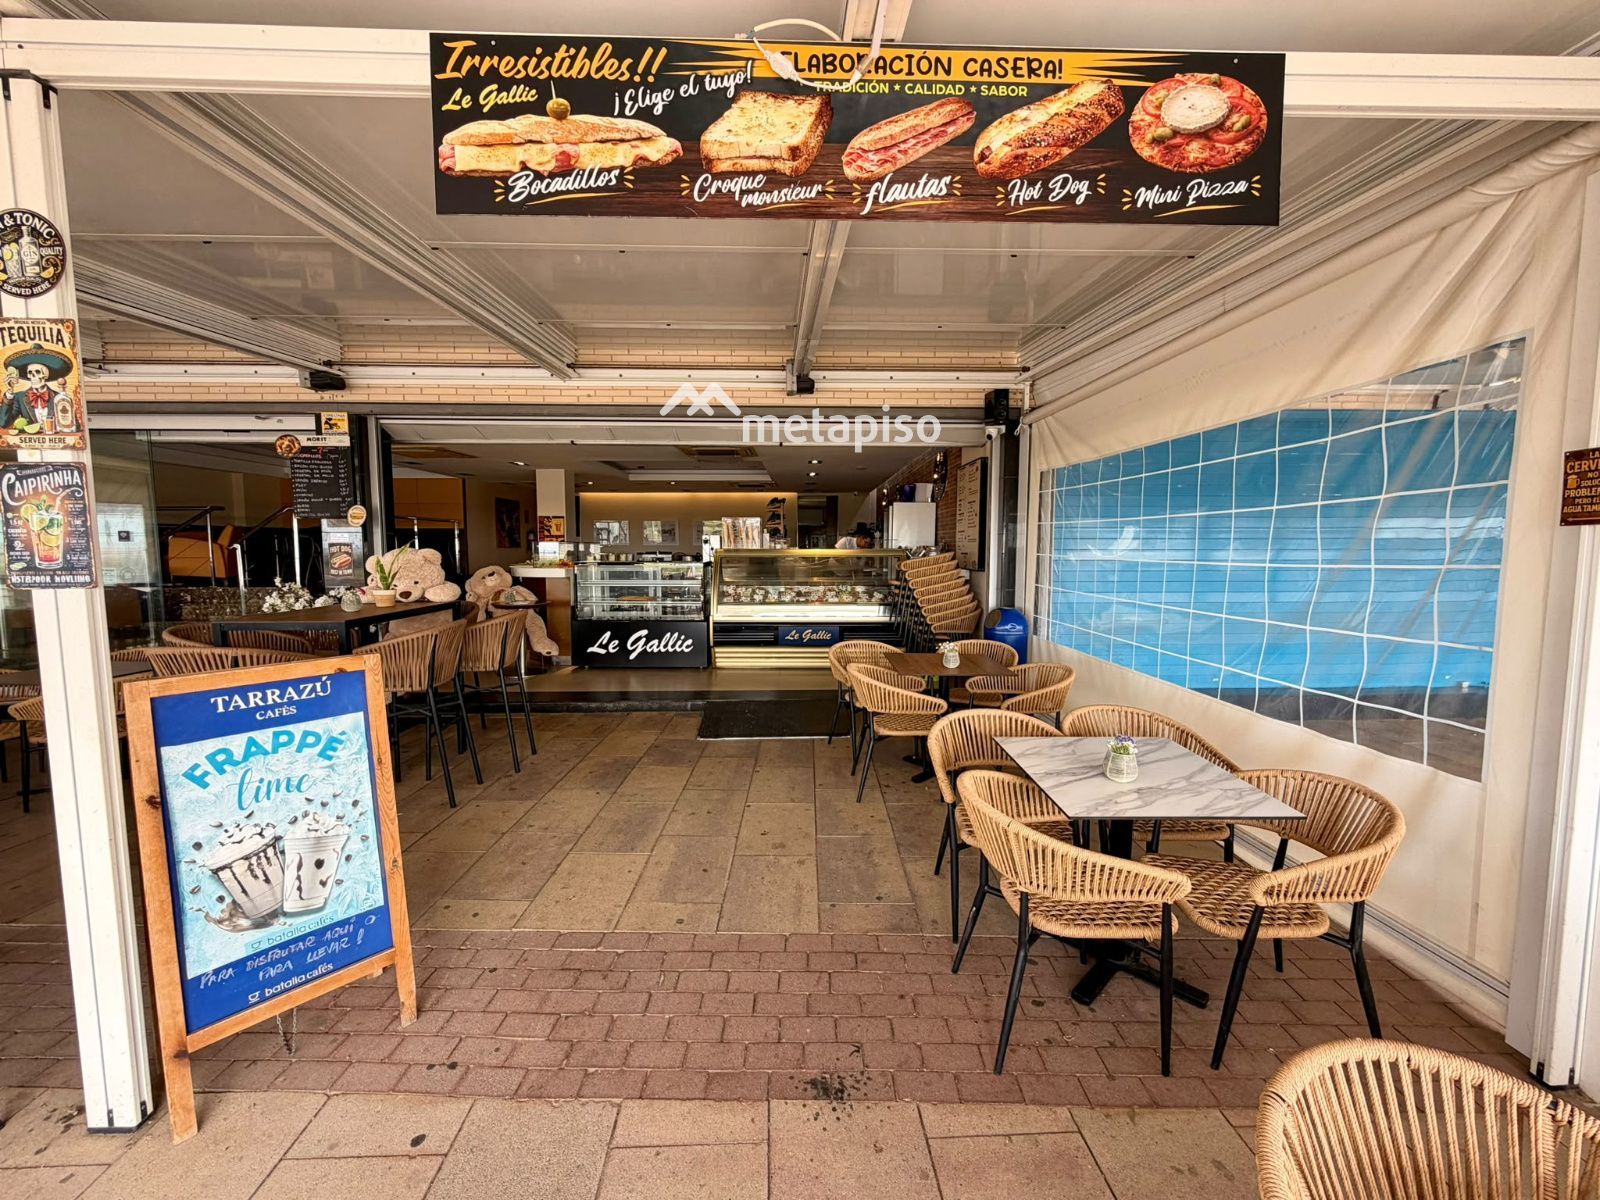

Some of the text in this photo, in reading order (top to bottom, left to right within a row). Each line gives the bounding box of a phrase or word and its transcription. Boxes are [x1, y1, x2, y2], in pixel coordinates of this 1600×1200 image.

[434, 40, 668, 83] Irresistibles!!
[781, 50, 1063, 81] LABOACIÓN CASERA!
[679, 73, 700, 98] el
[704, 59, 753, 99] tuyo!
[813, 80, 1028, 97] TRADICIÓN CALIDAD SABOR
[441, 83, 539, 113] Le Gallic
[507, 163, 621, 203] Bocadillos
[693, 173, 767, 202] Croque
[741, 183, 823, 208] monsieur
[859, 172, 953, 216] flautas
[1007, 173, 1093, 207] Hot Dog
[1134, 178, 1250, 210] Mini Pizza
[13, 212, 56, 239] TONIC
[2, 281, 52, 296] SERVED HERE
[19, 436, 47, 444] SERVED
[48, 436, 67, 444] HERE
[1590, 451, 1600, 459] LA
[1562, 505, 1582, 513] AGUA
[1574, 497, 1592, 505] PERO
[586, 629, 694, 660] Le Gallic
[784, 629, 832, 643] Le Gallic
[211, 676, 332, 713] TARRAZÚ
[255, 705, 298, 721] CAFÉS
[181, 729, 348, 791] FRAPPÉ
[224, 766, 320, 812] time
[307, 914, 335, 932] cafés
[199, 970, 236, 989] PARA
[246, 936, 316, 972] DISFRUTAR
[322, 916, 356, 941] AQUÍ
[258, 961, 294, 981] PARA
[306, 938, 350, 963] LLEVAR
[264, 962, 334, 997] batalla cafés
